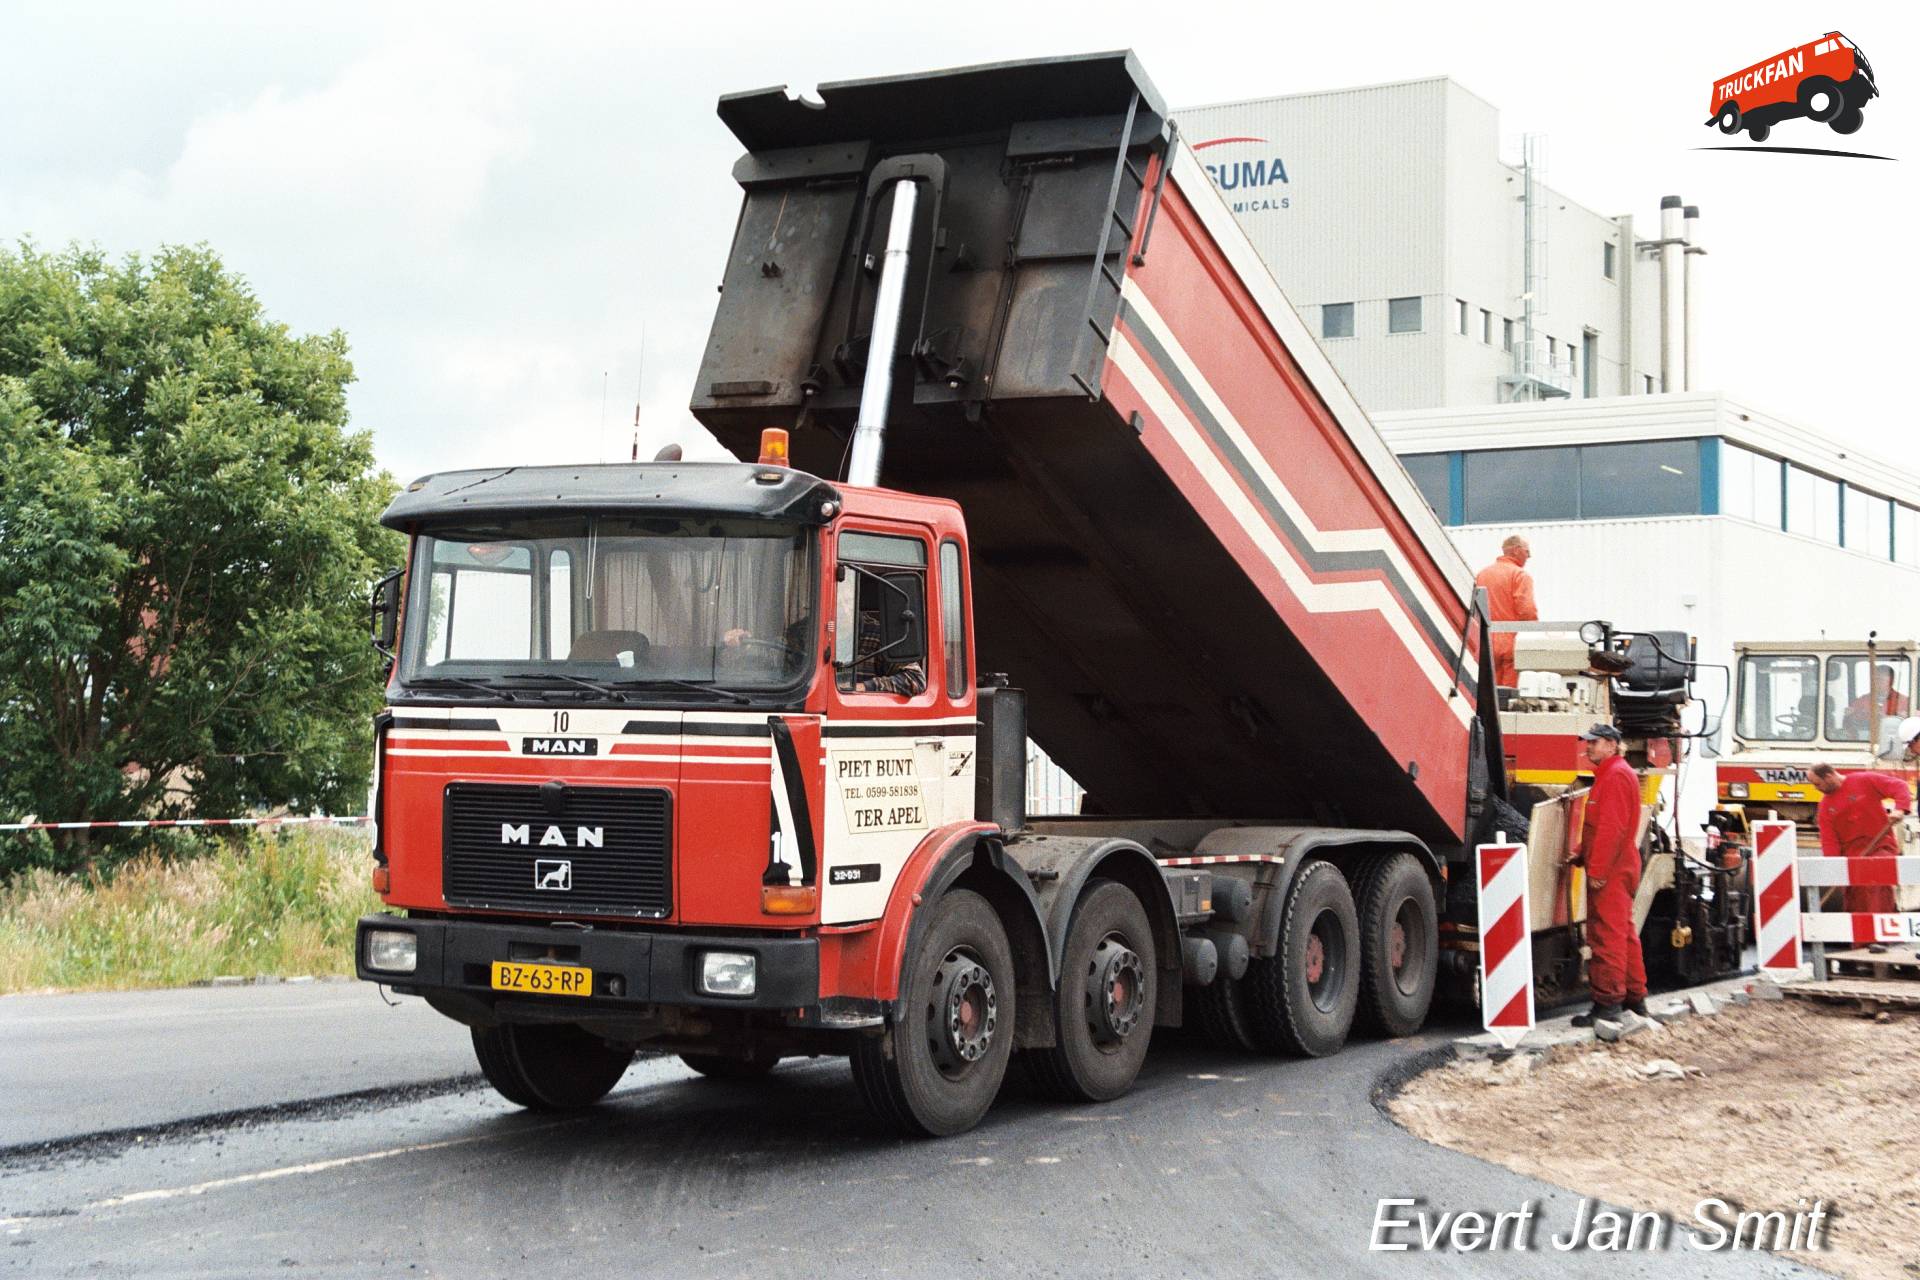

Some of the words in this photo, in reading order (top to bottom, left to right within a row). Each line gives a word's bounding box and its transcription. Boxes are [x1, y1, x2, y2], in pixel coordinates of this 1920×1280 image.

[553, 711, 569, 733] 10
[532, 739, 586, 753] MAN
[839, 760, 872, 778] PIET
[876, 758, 913, 777] BUNT
[845, 787, 863, 799] TEL.
[855, 808, 883, 827] TER
[887, 806, 922, 825] APEL
[501, 823, 604, 848] MAN
[500, 966, 585, 992] BZ-63-RP
